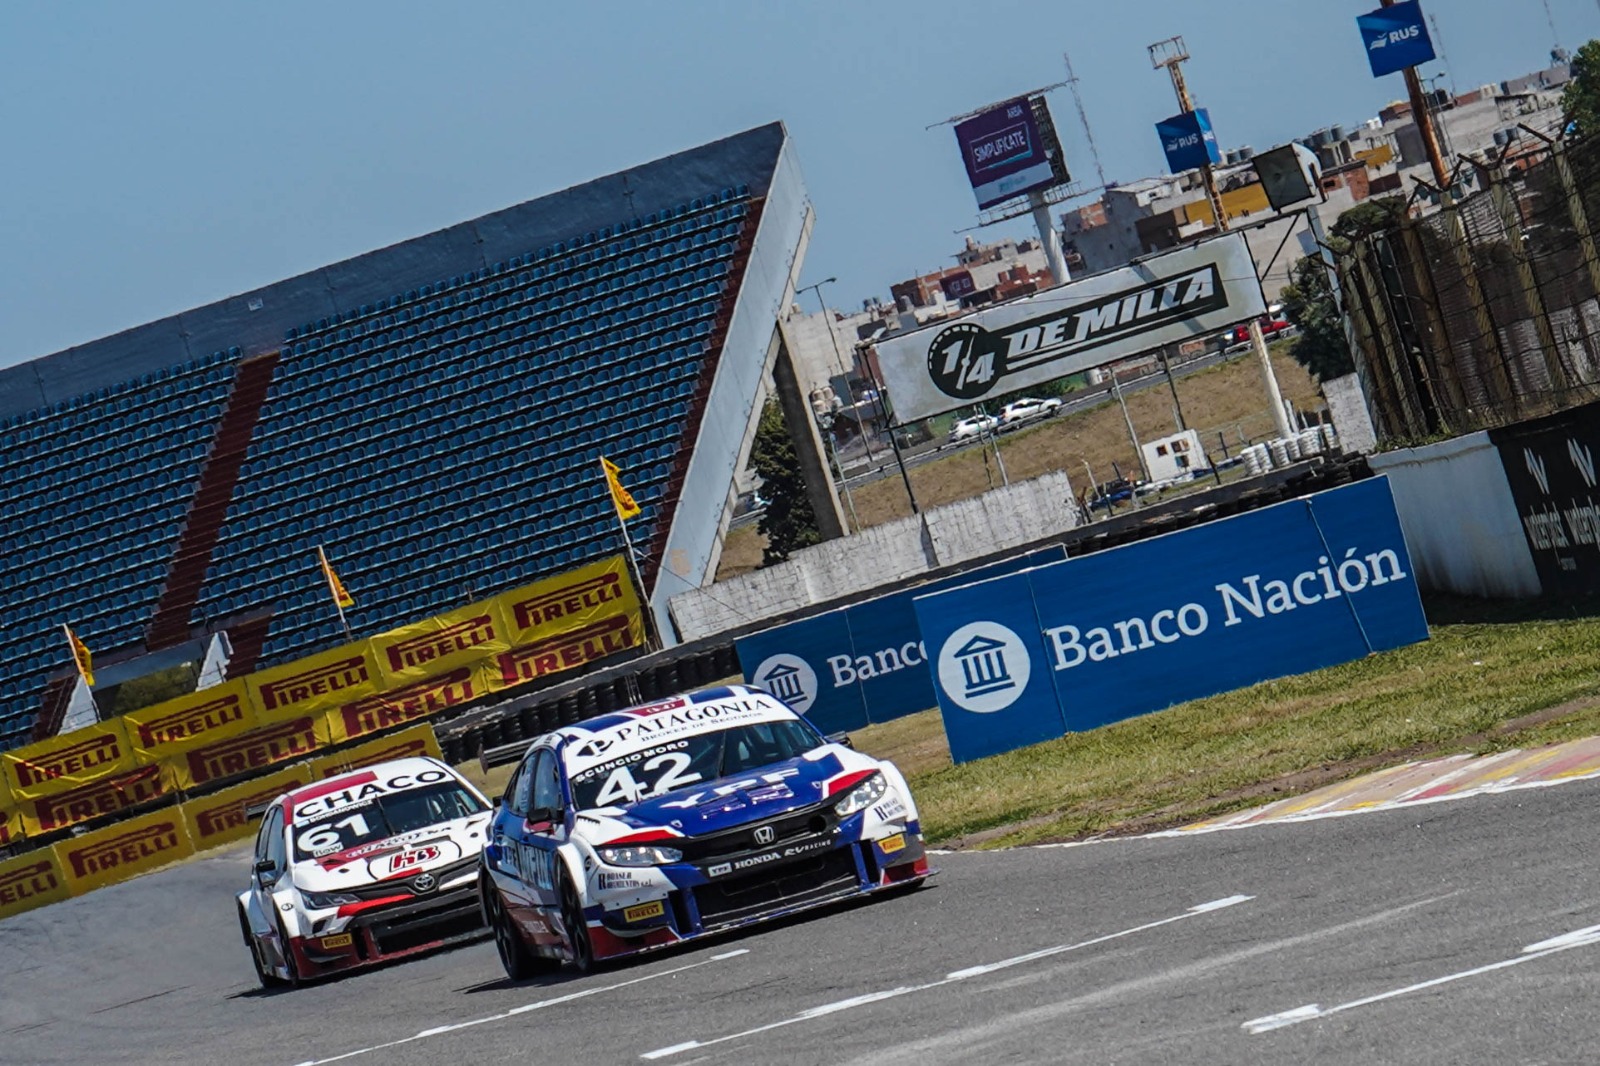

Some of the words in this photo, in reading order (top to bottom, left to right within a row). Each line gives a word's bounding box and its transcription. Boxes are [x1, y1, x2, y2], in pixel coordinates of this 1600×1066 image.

[1389, 25, 1419, 43] RUS
[1178, 133, 1199, 148] RUS
[1002, 322, 1068, 358] DE
[1072, 265, 1215, 341] MILLA
[512, 571, 623, 630] PIRELLI
[1045, 602, 1209, 672] Banco
[1215, 546, 1407, 629] Nación
[386, 614, 495, 673] PIRELLI
[496, 614, 634, 686] PIRELLI
[259, 655, 370, 711] PIRELLI
[341, 667, 474, 738] PIRELLI
[137, 694, 243, 749] PIRELLI
[616, 698, 772, 741] PATAGONIA
[15, 733, 121, 788] PIRELLI
[186, 716, 316, 784] PIRELLI
[575, 754, 640, 783] SCUNCIO
[643, 740, 690, 758] MORO
[34, 763, 163, 831] PIRELLI
[296, 770, 447, 819] CHACO
[595, 752, 703, 807] 42
[68, 822, 179, 879] PIRELLI
[297, 813, 371, 852] 61
[734, 852, 782, 870] HONDA
